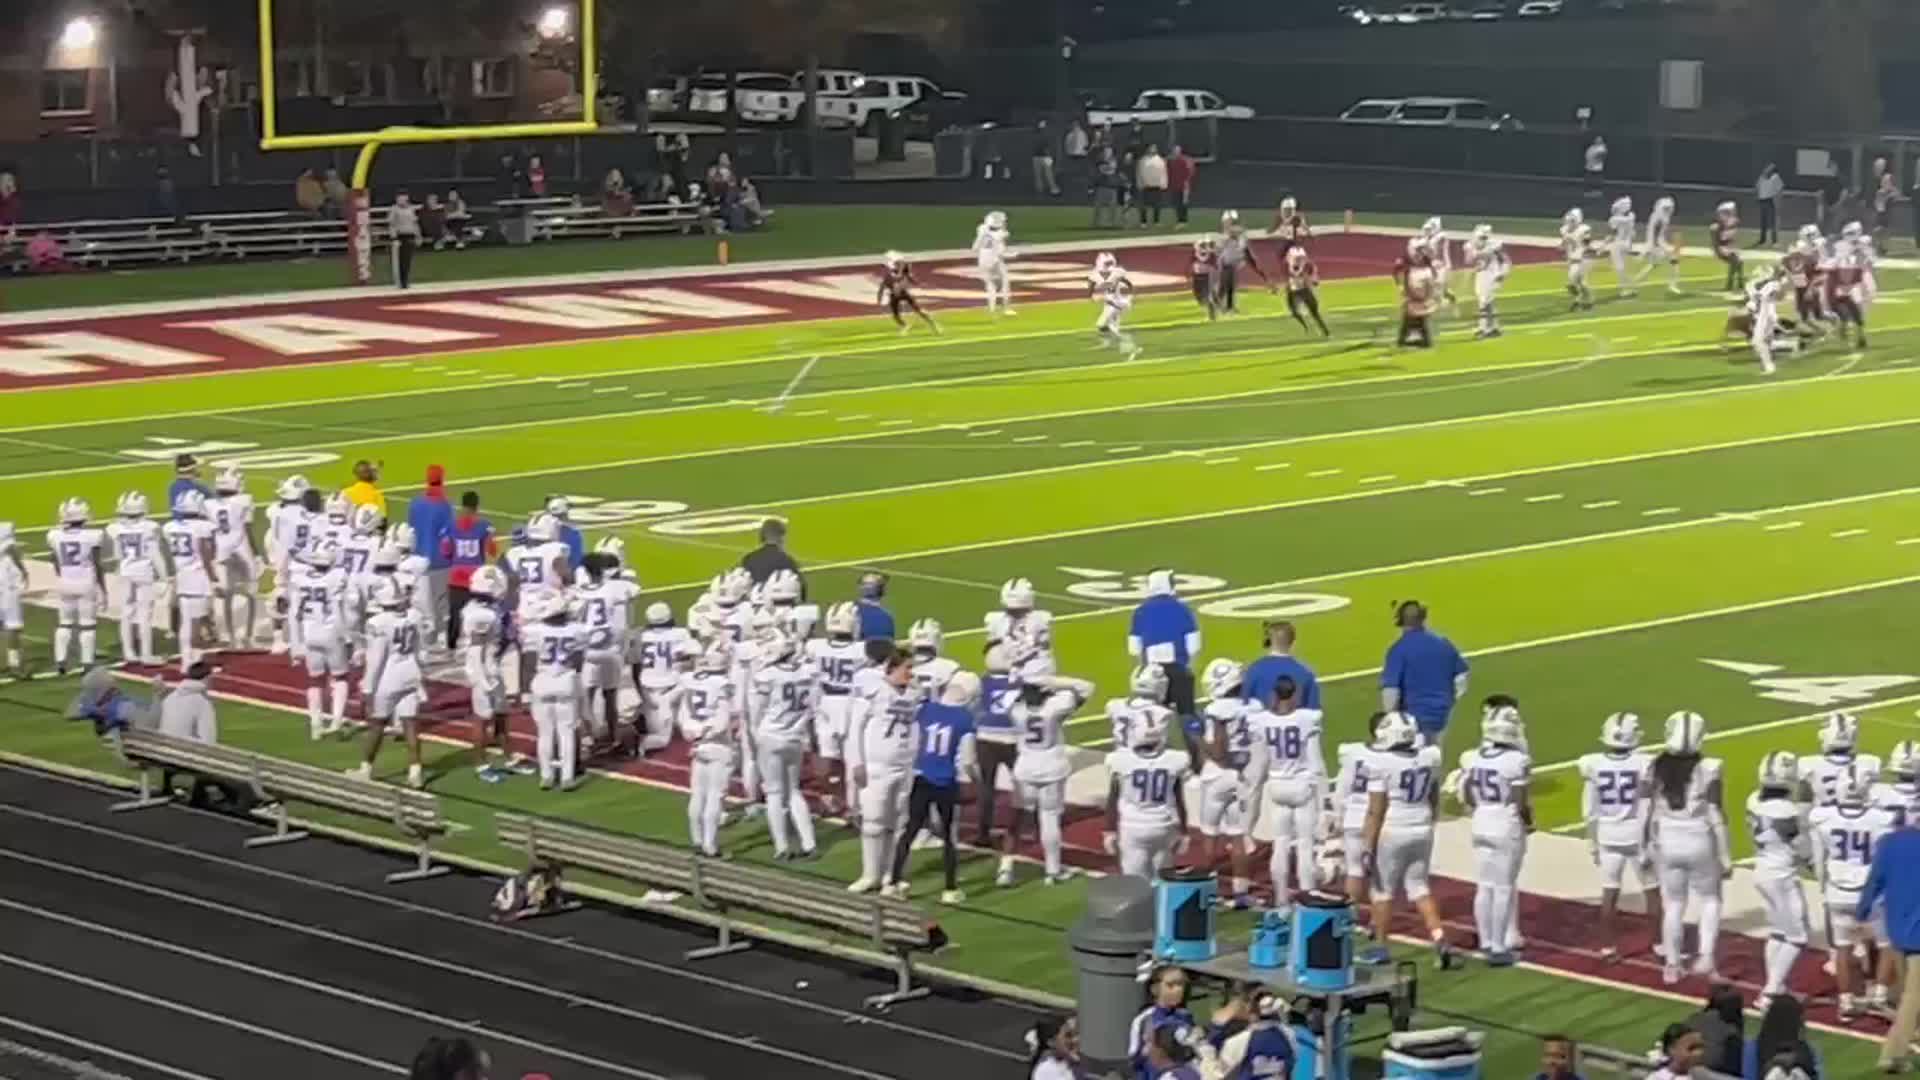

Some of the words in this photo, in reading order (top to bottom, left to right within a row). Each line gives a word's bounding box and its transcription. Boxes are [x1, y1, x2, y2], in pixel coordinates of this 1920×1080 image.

[60, 541, 81, 566] 12
[168, 532, 192, 557] 33
[1055, 566, 1353, 618] 30
[925, 721, 953, 757] 11
[1265, 725, 1301, 760] 48
[1133, 767, 1169, 804] 90
[1597, 770, 1638, 805] 22
[1830, 828, 1872, 866] 34
